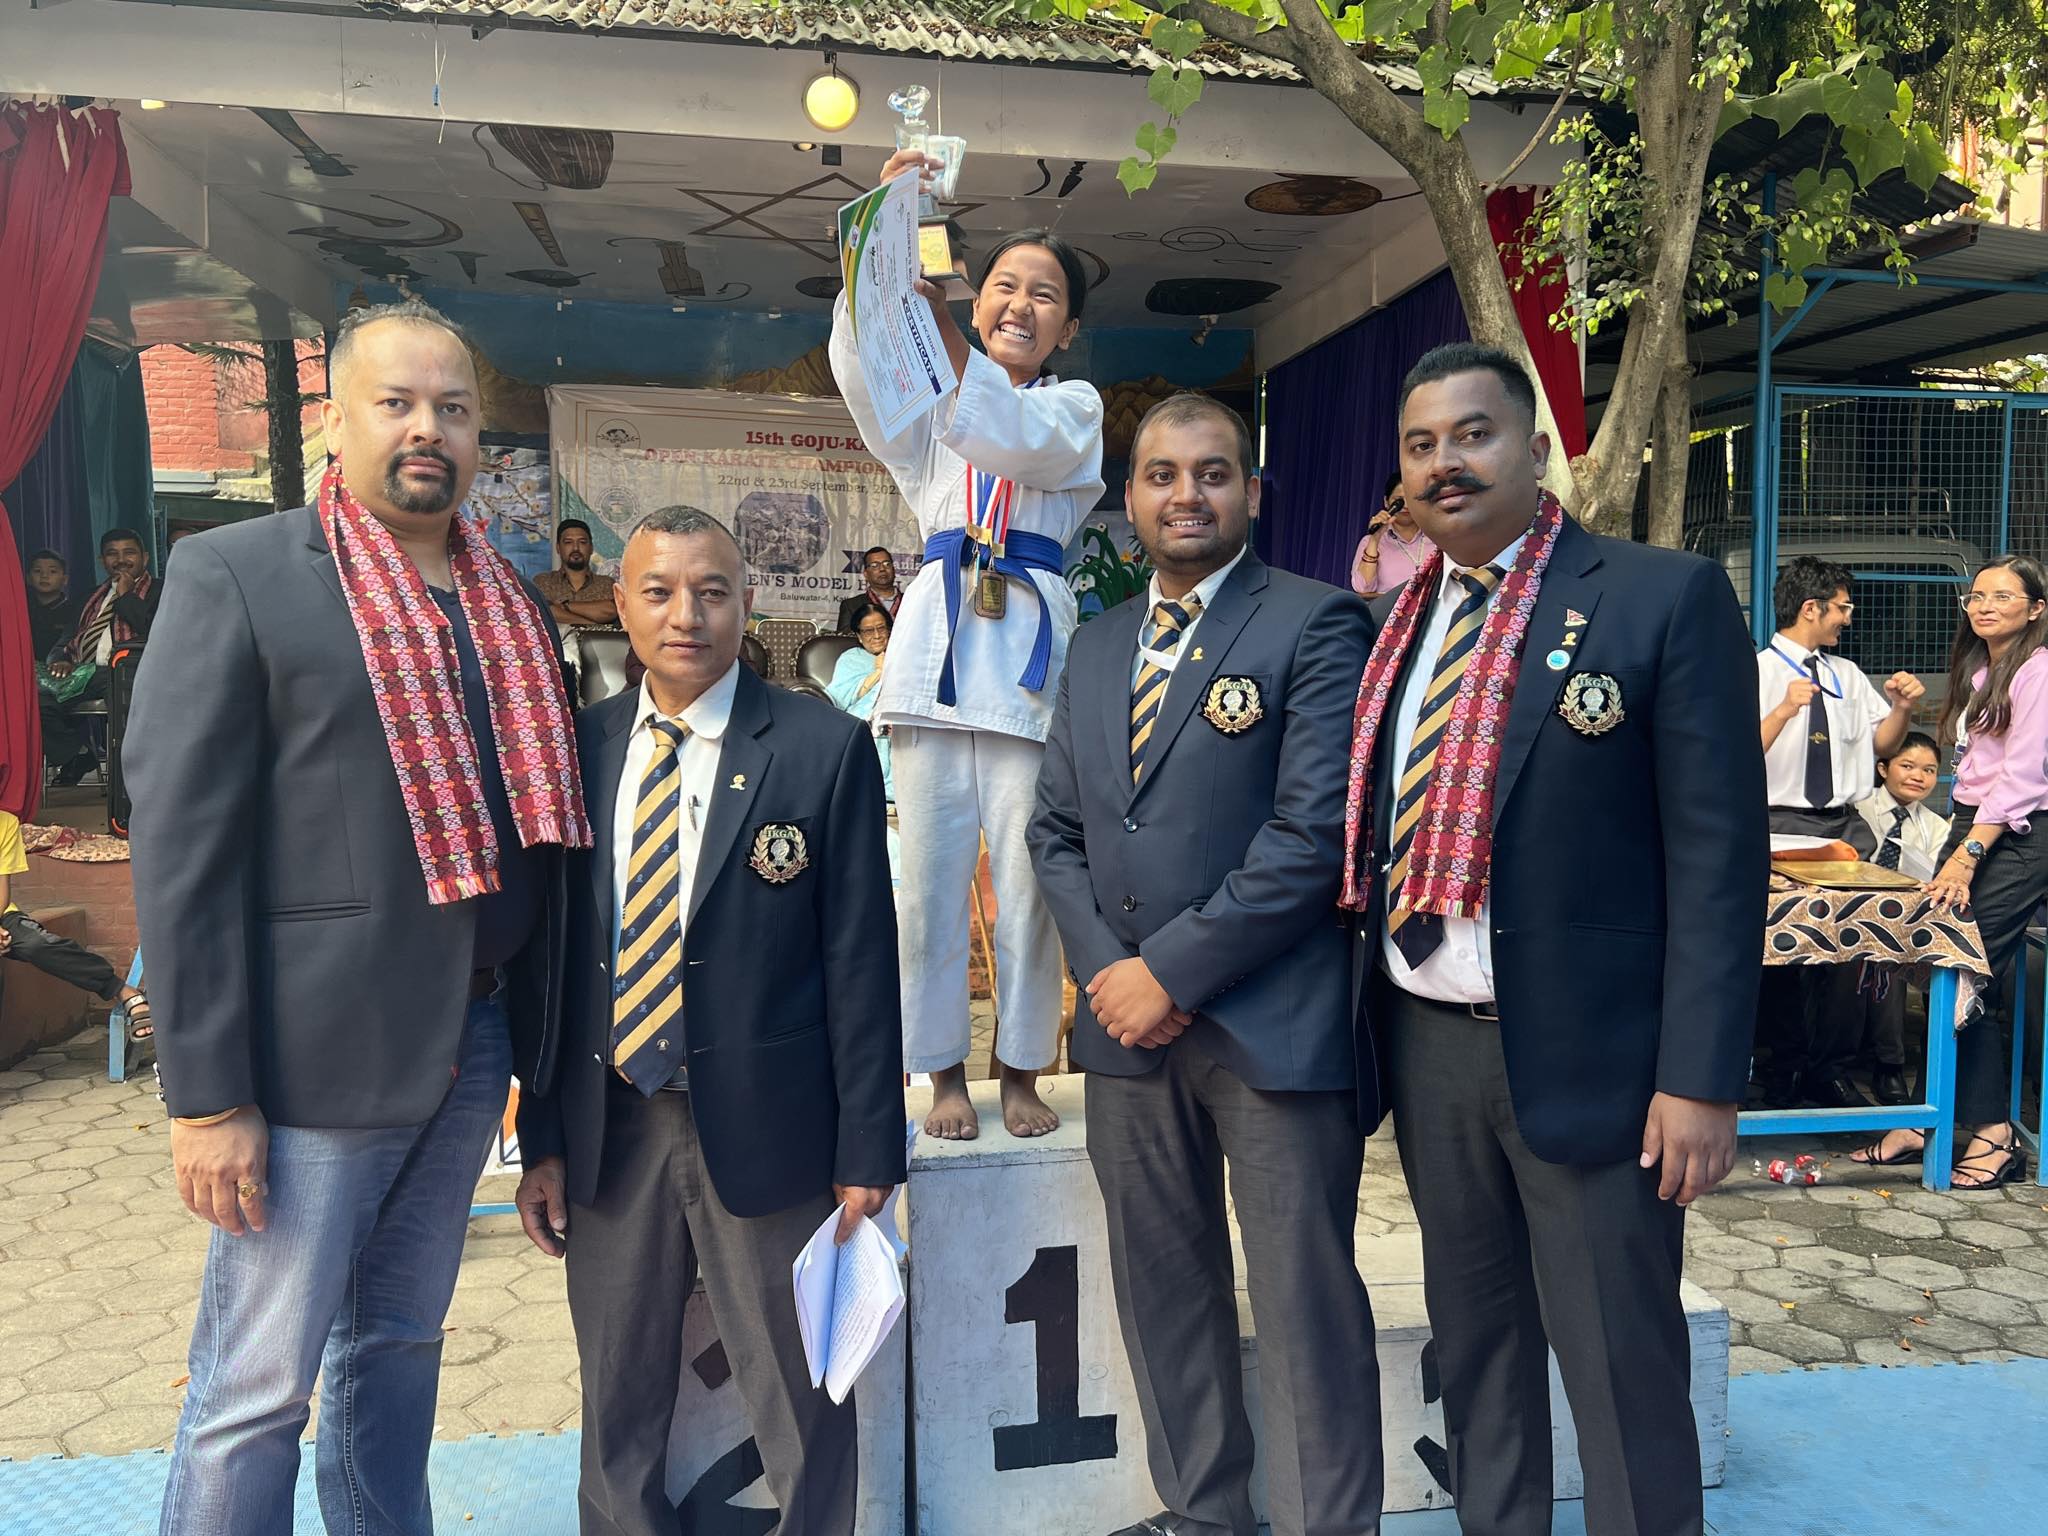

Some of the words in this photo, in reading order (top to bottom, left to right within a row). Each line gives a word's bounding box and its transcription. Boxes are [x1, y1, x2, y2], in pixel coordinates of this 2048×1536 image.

[904, 303, 935, 379] CERTIFICATE
[745, 430, 785, 446] 15th
[644, 448, 697, 464] OPEN
[703, 451, 778, 469] KARATE
[718, 474, 750, 487] 22nd
[754, 476, 765, 487] &
[768, 477, 798, 489] 23rd
[800, 478, 869, 495] September,
[873, 483, 902, 496] 202
[791, 575, 852, 590] MODEL
[1220, 681, 1249, 690] IKGA
[1579, 678, 1610, 688] IKGA
[767, 829, 795, 838] IKGA
[993, 1244, 1118, 1472] 1
